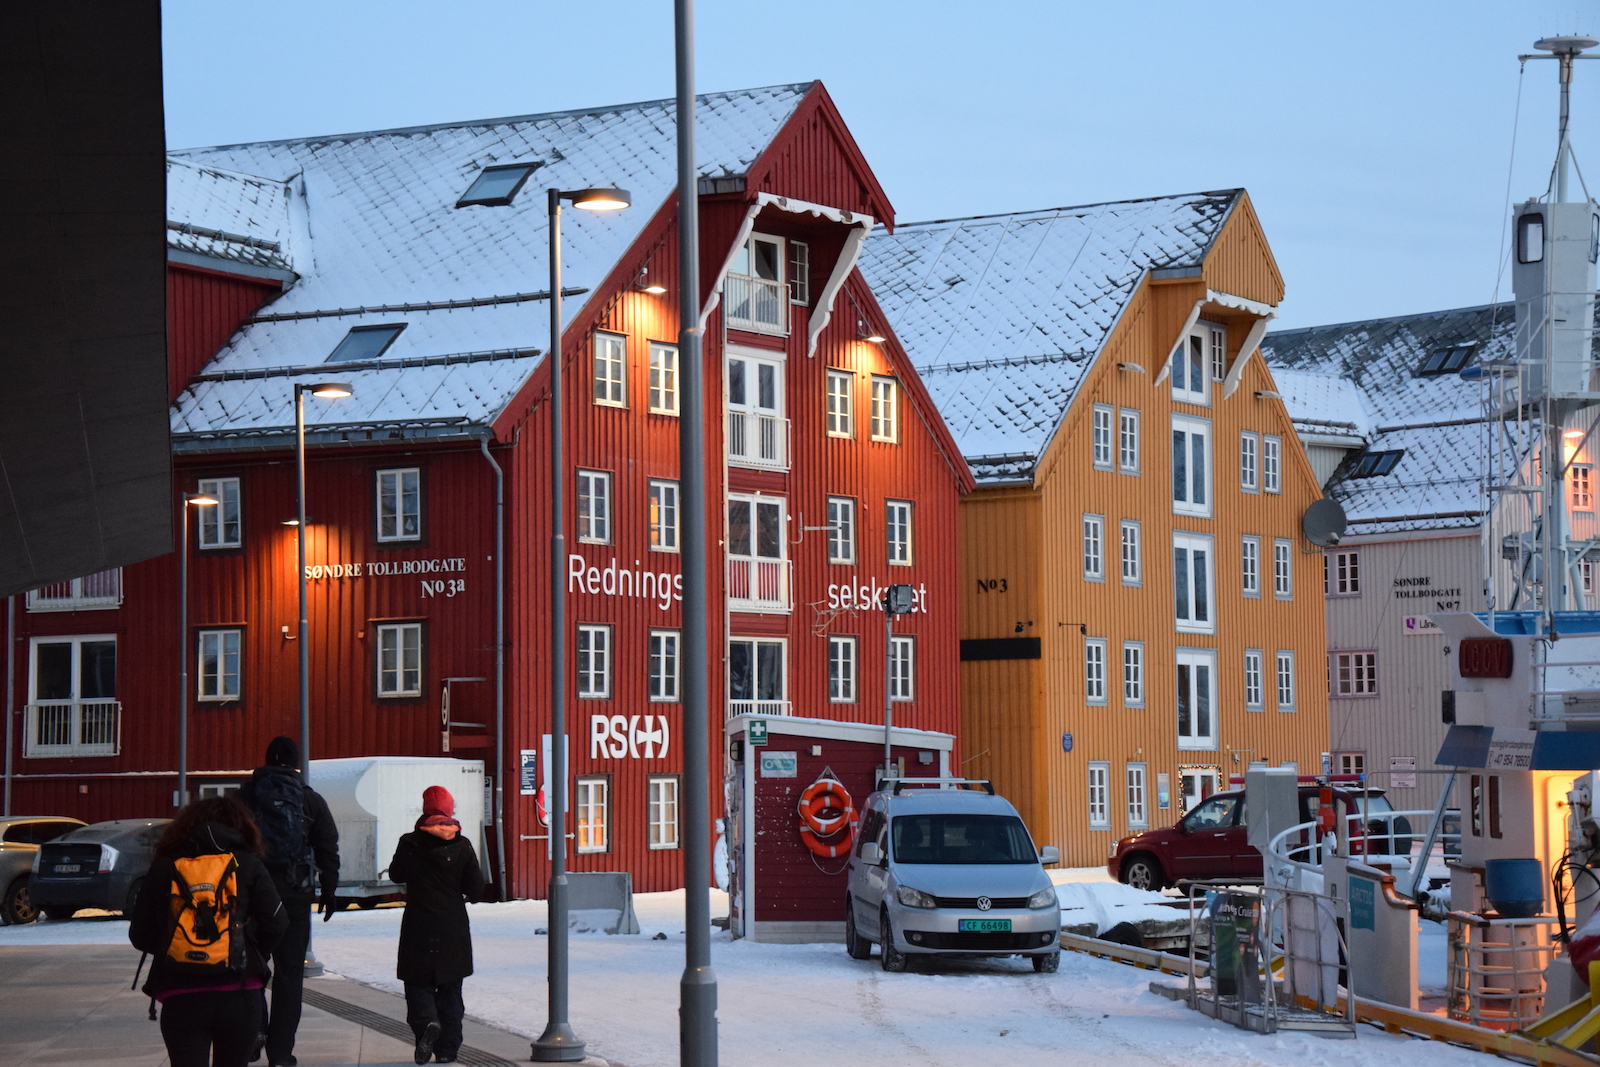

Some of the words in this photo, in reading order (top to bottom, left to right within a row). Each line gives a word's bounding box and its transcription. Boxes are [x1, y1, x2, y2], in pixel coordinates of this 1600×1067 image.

[305, 563, 362, 579] SØNDRE
[366, 558, 466, 576] TOLLBODGATE
[568, 554, 682, 611] Rednings
[1393, 577, 1431, 587] SØNDRE
[828, 575, 927, 622] selsket
[1395, 588, 1462, 599] TOLLBODGATE
[966, 921, 977, 930] CF
[981, 921, 1009, 931] 66498
